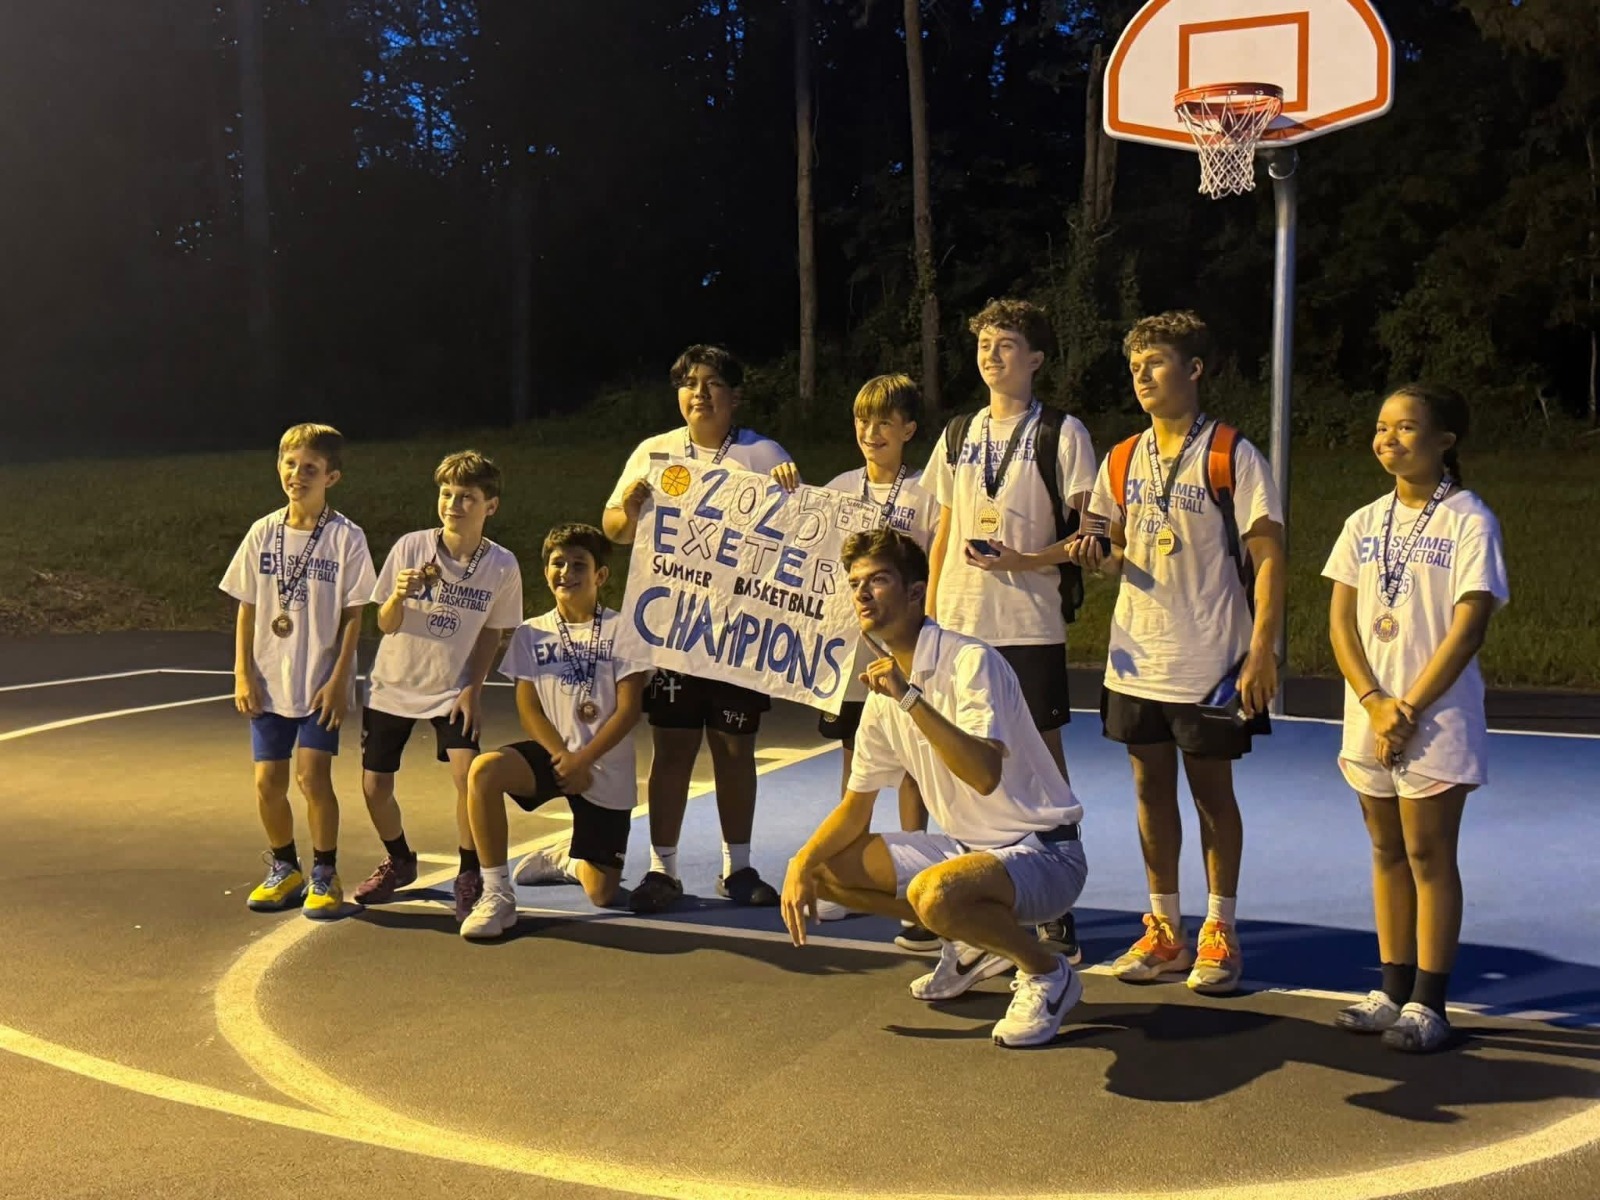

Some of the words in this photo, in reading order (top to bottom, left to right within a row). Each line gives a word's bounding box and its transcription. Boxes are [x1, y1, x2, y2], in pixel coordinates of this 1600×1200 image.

[695, 469, 830, 549] 2025
[653, 506, 839, 595] EXETER
[652, 555, 713, 589] SUMMER
[441, 582, 493, 602] SUMMER
[733, 577, 825, 620] BASKETBALL
[430, 614, 457, 630] 2025
[534, 643, 558, 666] EX
[633, 586, 846, 699] CHAMPIONS
